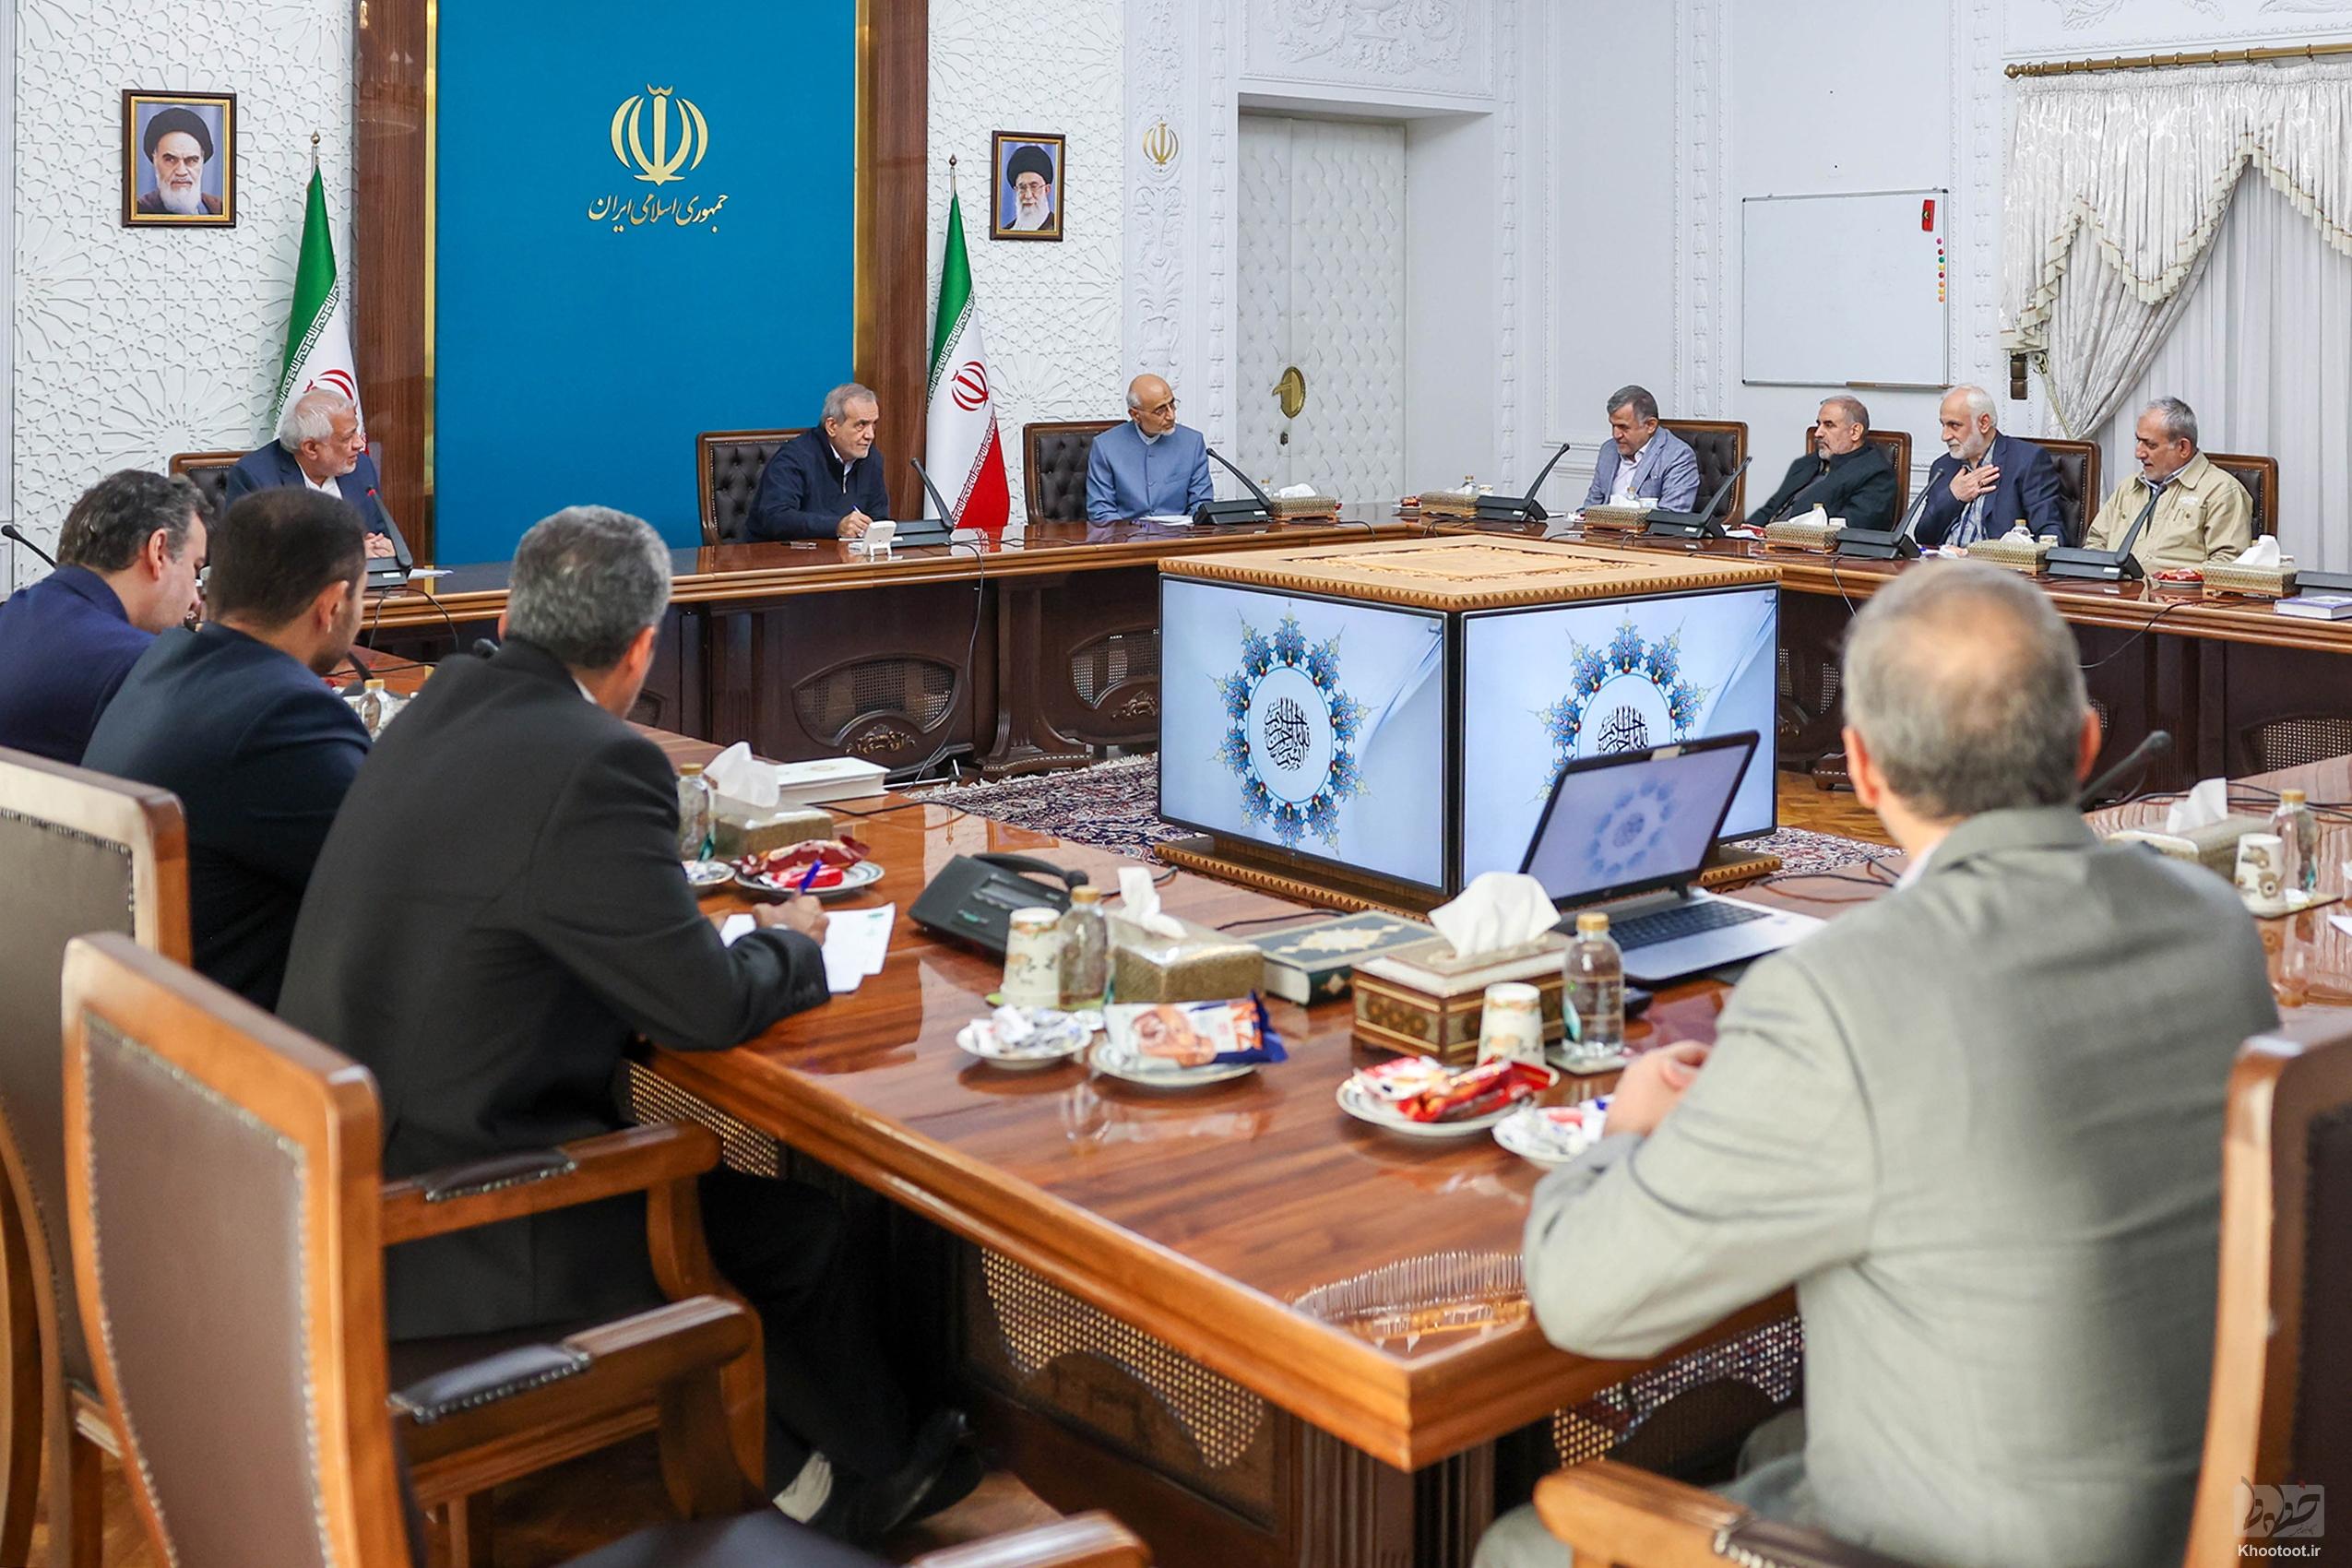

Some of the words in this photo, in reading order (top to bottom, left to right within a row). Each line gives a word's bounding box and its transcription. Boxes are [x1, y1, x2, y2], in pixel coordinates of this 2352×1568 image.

[588, 194, 633, 233] ایران
[629, 193, 678, 226] اسلامی
[674, 194, 730, 233] جمهوری
